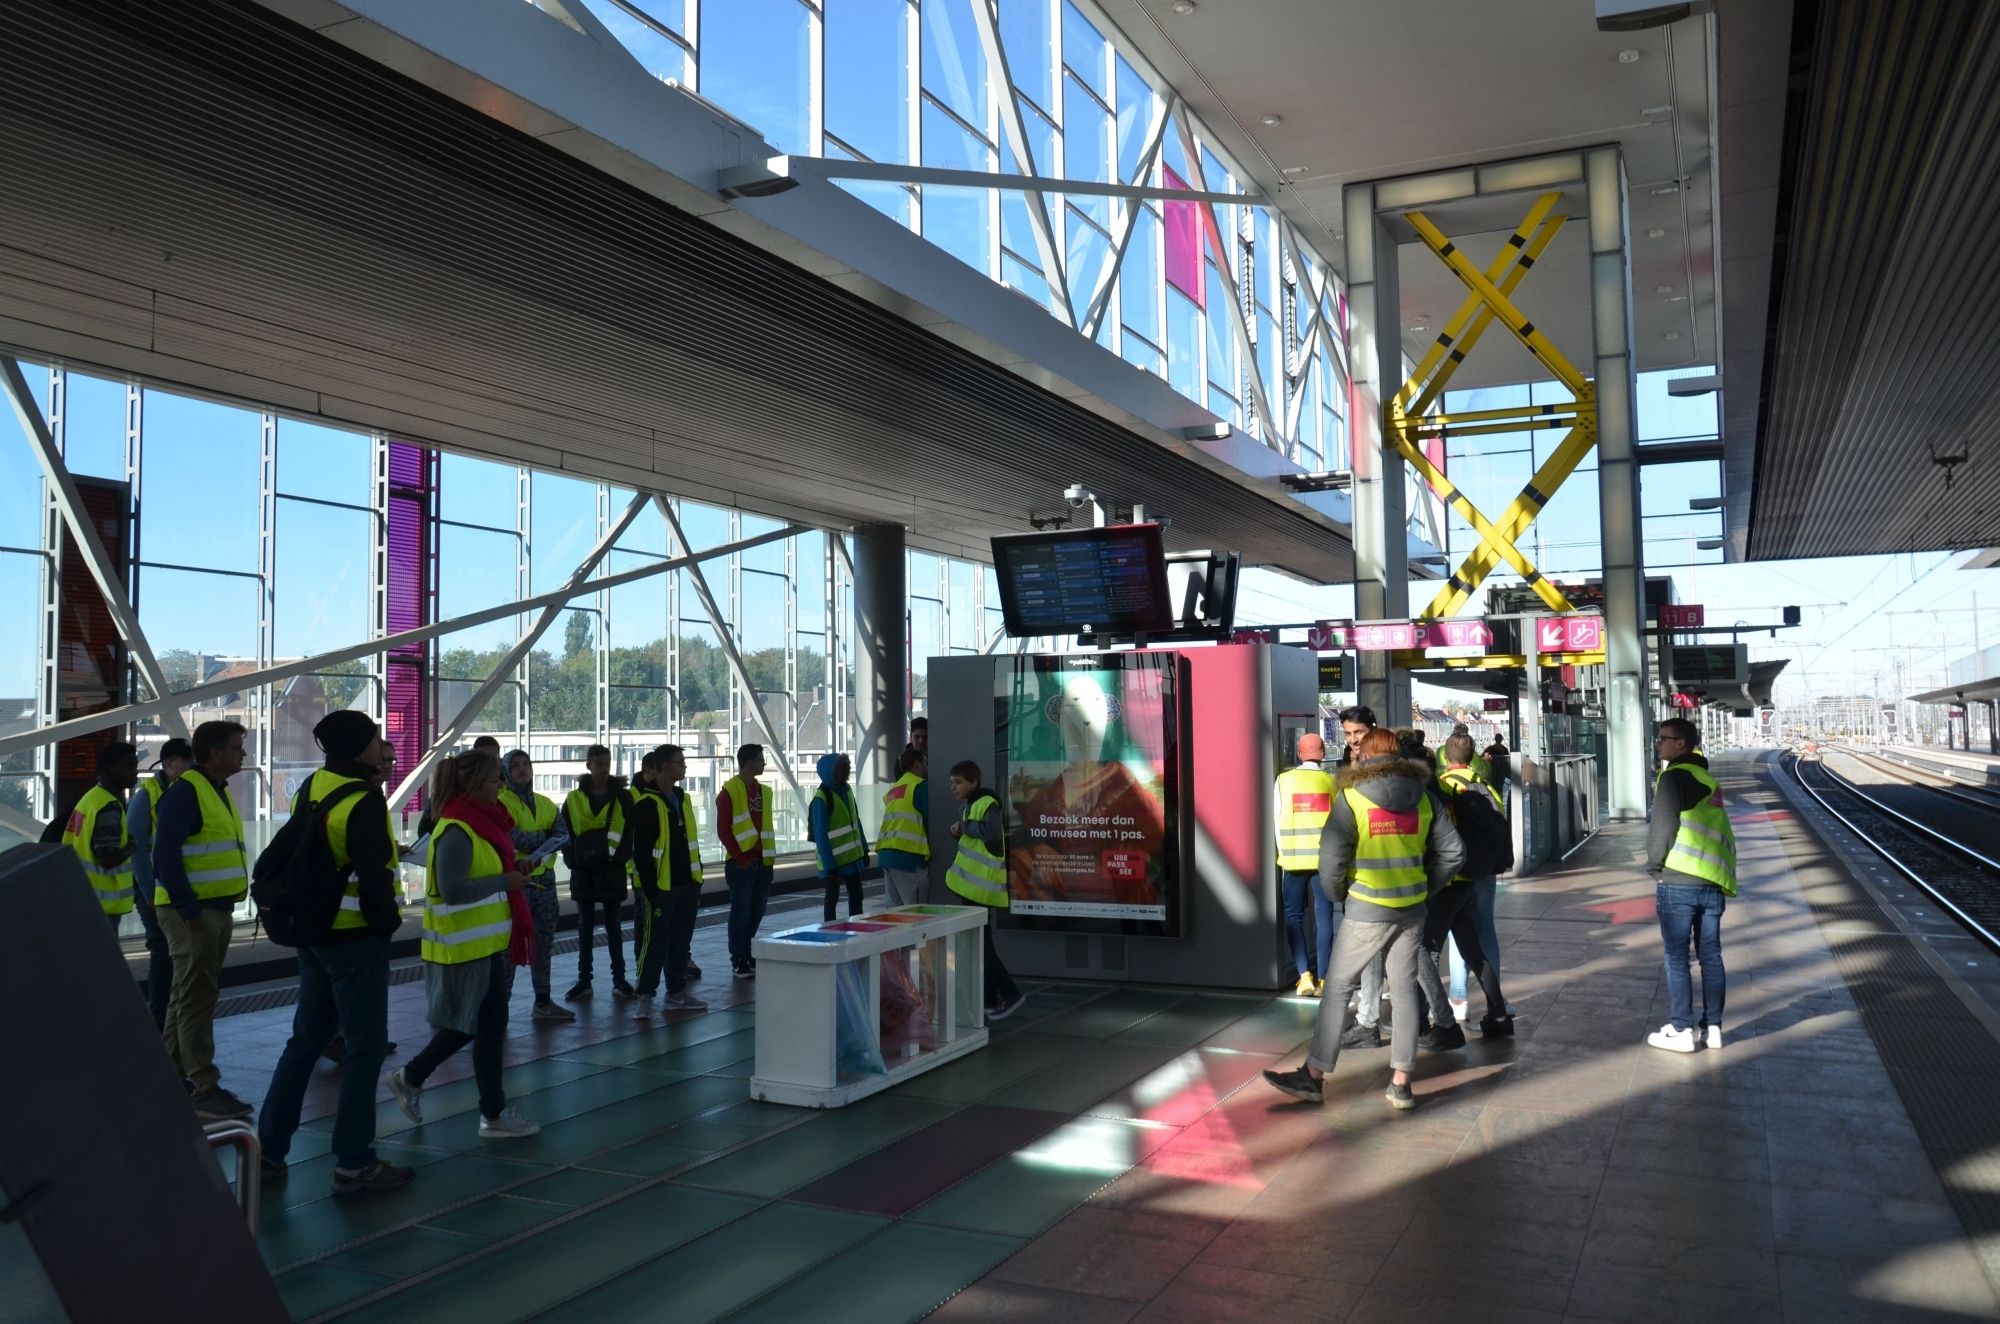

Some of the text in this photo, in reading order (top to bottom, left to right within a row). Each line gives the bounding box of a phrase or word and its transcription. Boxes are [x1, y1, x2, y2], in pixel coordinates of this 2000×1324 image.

[1664, 611, 1697, 624] 11 B
[1414, 628, 1426, 644] P
[1040, 815, 1135, 825] Bezoek meer dan
[1370, 821, 1396, 829] project
[1030, 828, 1047, 838] 100
[1050, 829, 1087, 839] musea
[1089, 829, 1112, 839] met
[1121, 830, 1145, 841] pas.
